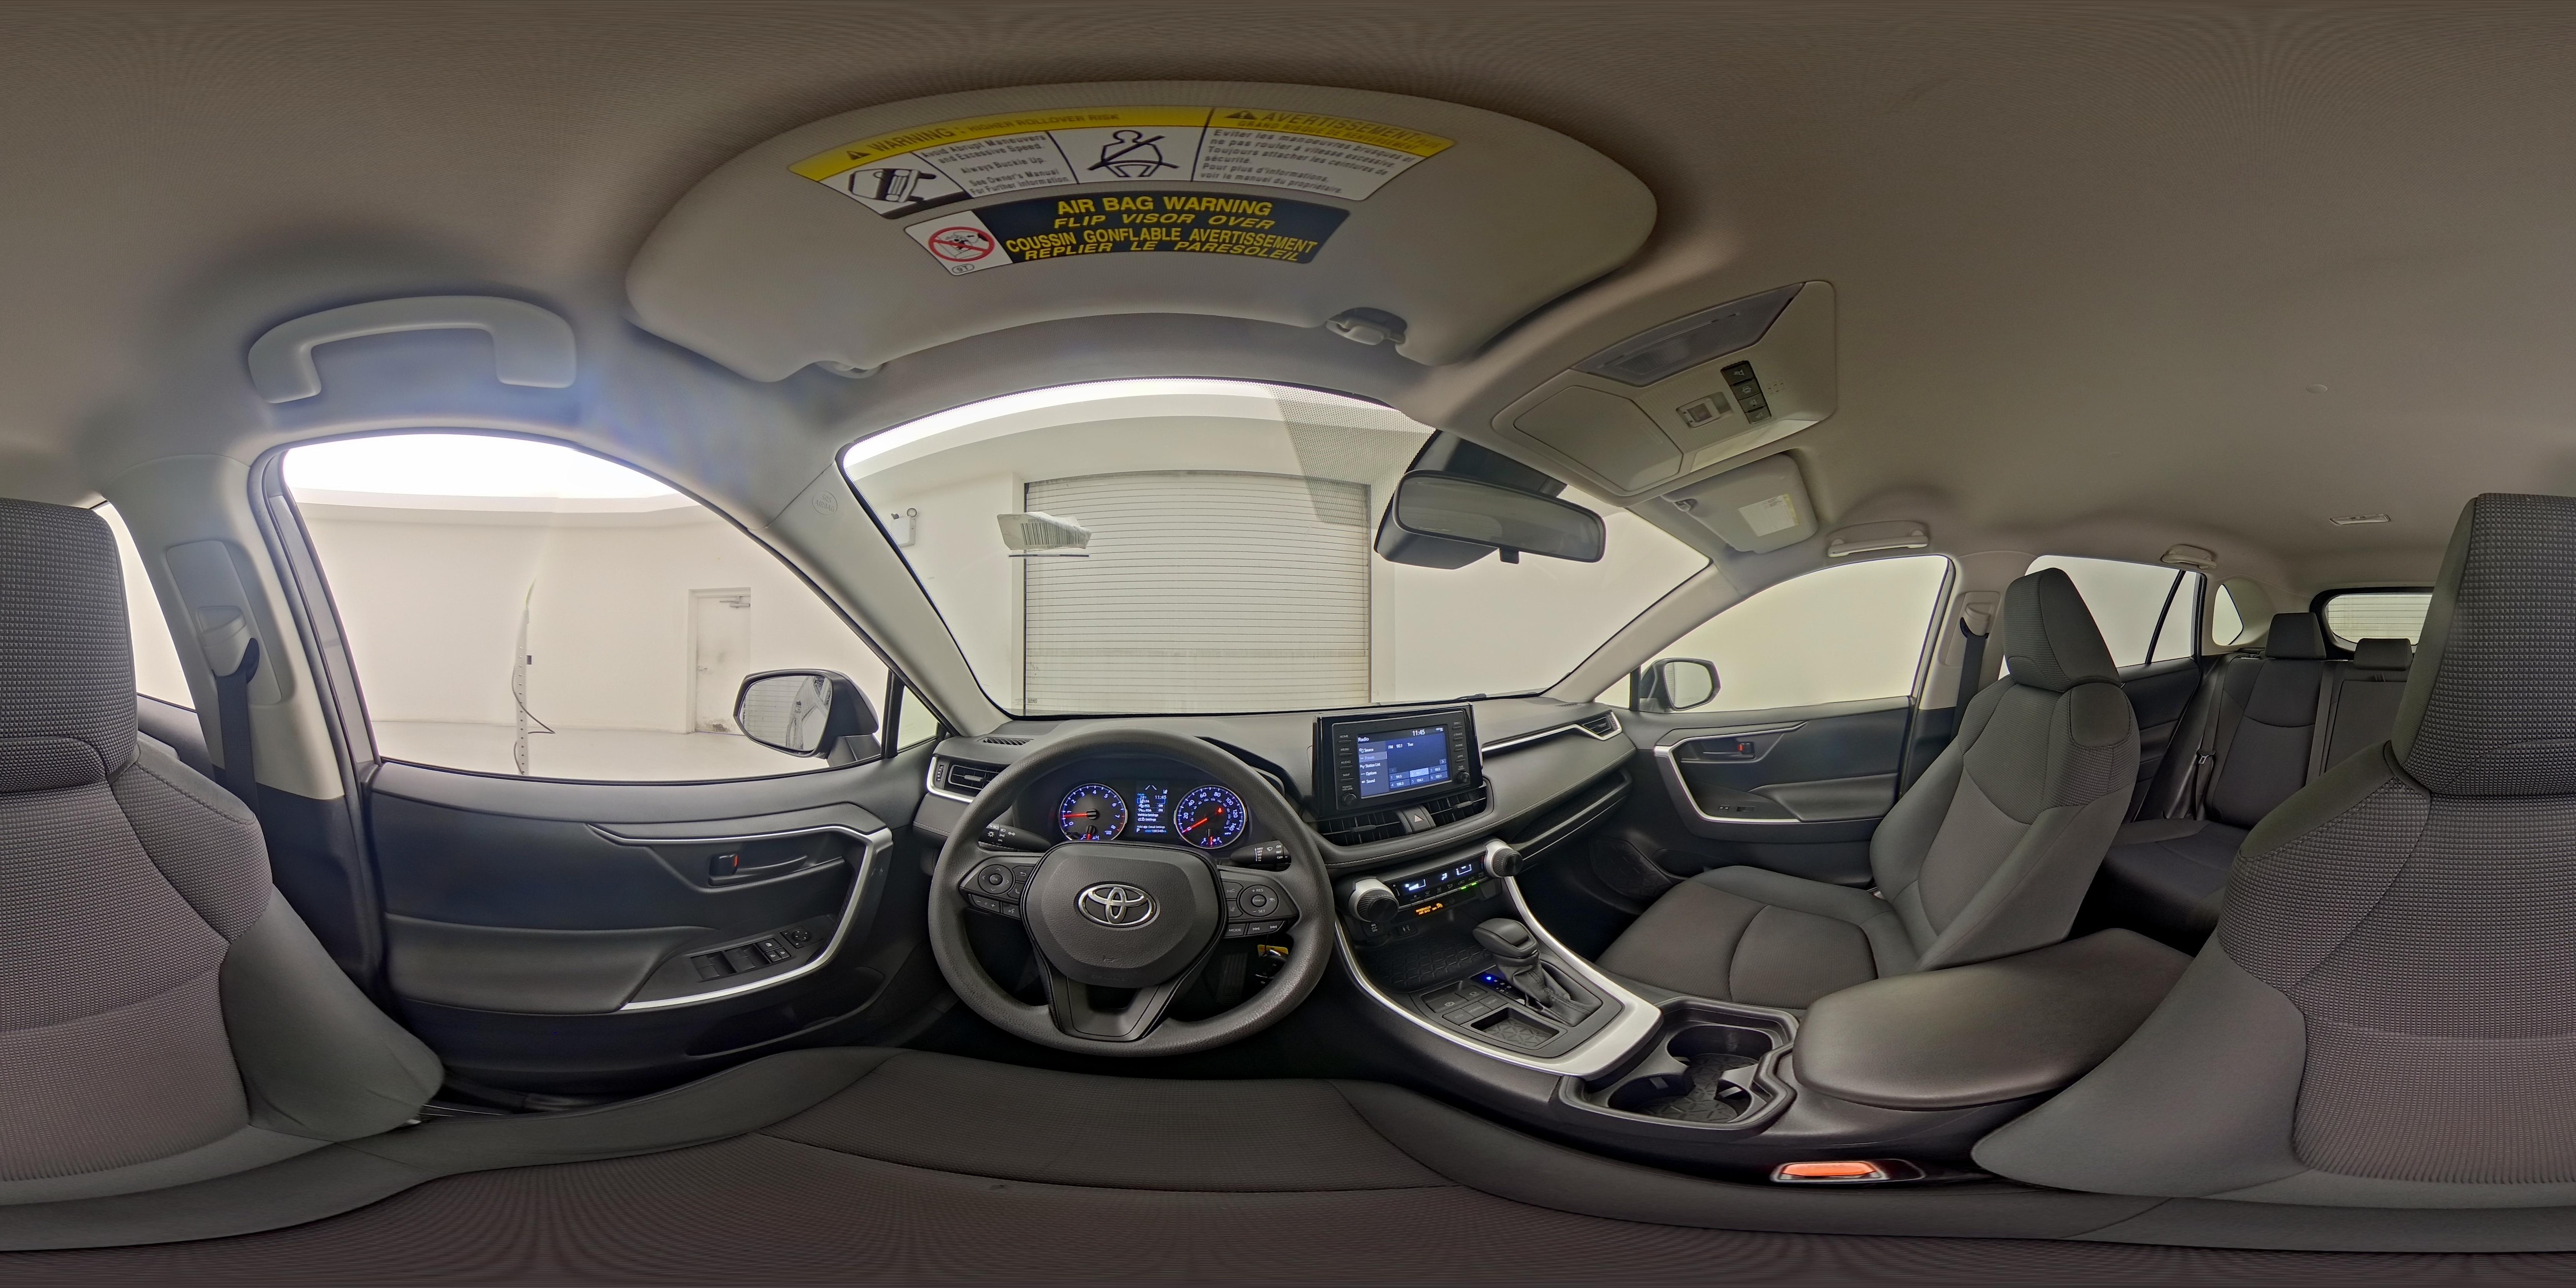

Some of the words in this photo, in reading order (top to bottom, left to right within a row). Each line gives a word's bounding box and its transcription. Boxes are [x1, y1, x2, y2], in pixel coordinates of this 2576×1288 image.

[968, 122, 1014, 132] HIGHER
[1016, 116, 1085, 126] ROLLOVER
[921, 148, 949, 157] Avoid
[949, 142, 985, 151] Abrupt
[985, 135, 1046, 146] Maneuvers
[956, 148, 1007, 160] Excessive
[1007, 144, 1045, 152] Speed.
[1304, 147, 1344, 157] vitesse
[1352, 146, 1402, 160] brusques
[960, 164, 993, 174] Always
[993, 159, 1027, 168] Buckle
[1208, 146, 1259, 155] Toujours
[1262, 151, 1309, 160] attacher
[1328, 160, 1375, 172] ceintures
[987, 173, 1024, 183] Owner's
[1025, 169, 1059, 178] Manual
[985, 182, 1016, 192] Further
[1058, 199, 1096, 215] AIR
[1102, 196, 1153, 211] BAG
[1163, 196, 1273, 216] WARNING
[1054, 214, 1106, 229] FLIP
[1122, 213, 1195, 224] VISOR
[1208, 215, 1275, 230] OVER
[1006, 232, 1076, 253] COUSSIN
[1083, 228, 1181, 243] GONFLABLE
[1189, 228, 1317, 254] AVERTISSEMENT
[1025, 243, 1112, 260] REPLIER
[1130, 241, 1158, 251] LE
[1174, 242, 1298, 261] PARESOLEIL
[816, 499, 835, 512] AIRBAG
[821, 494, 832, 503] SRS
